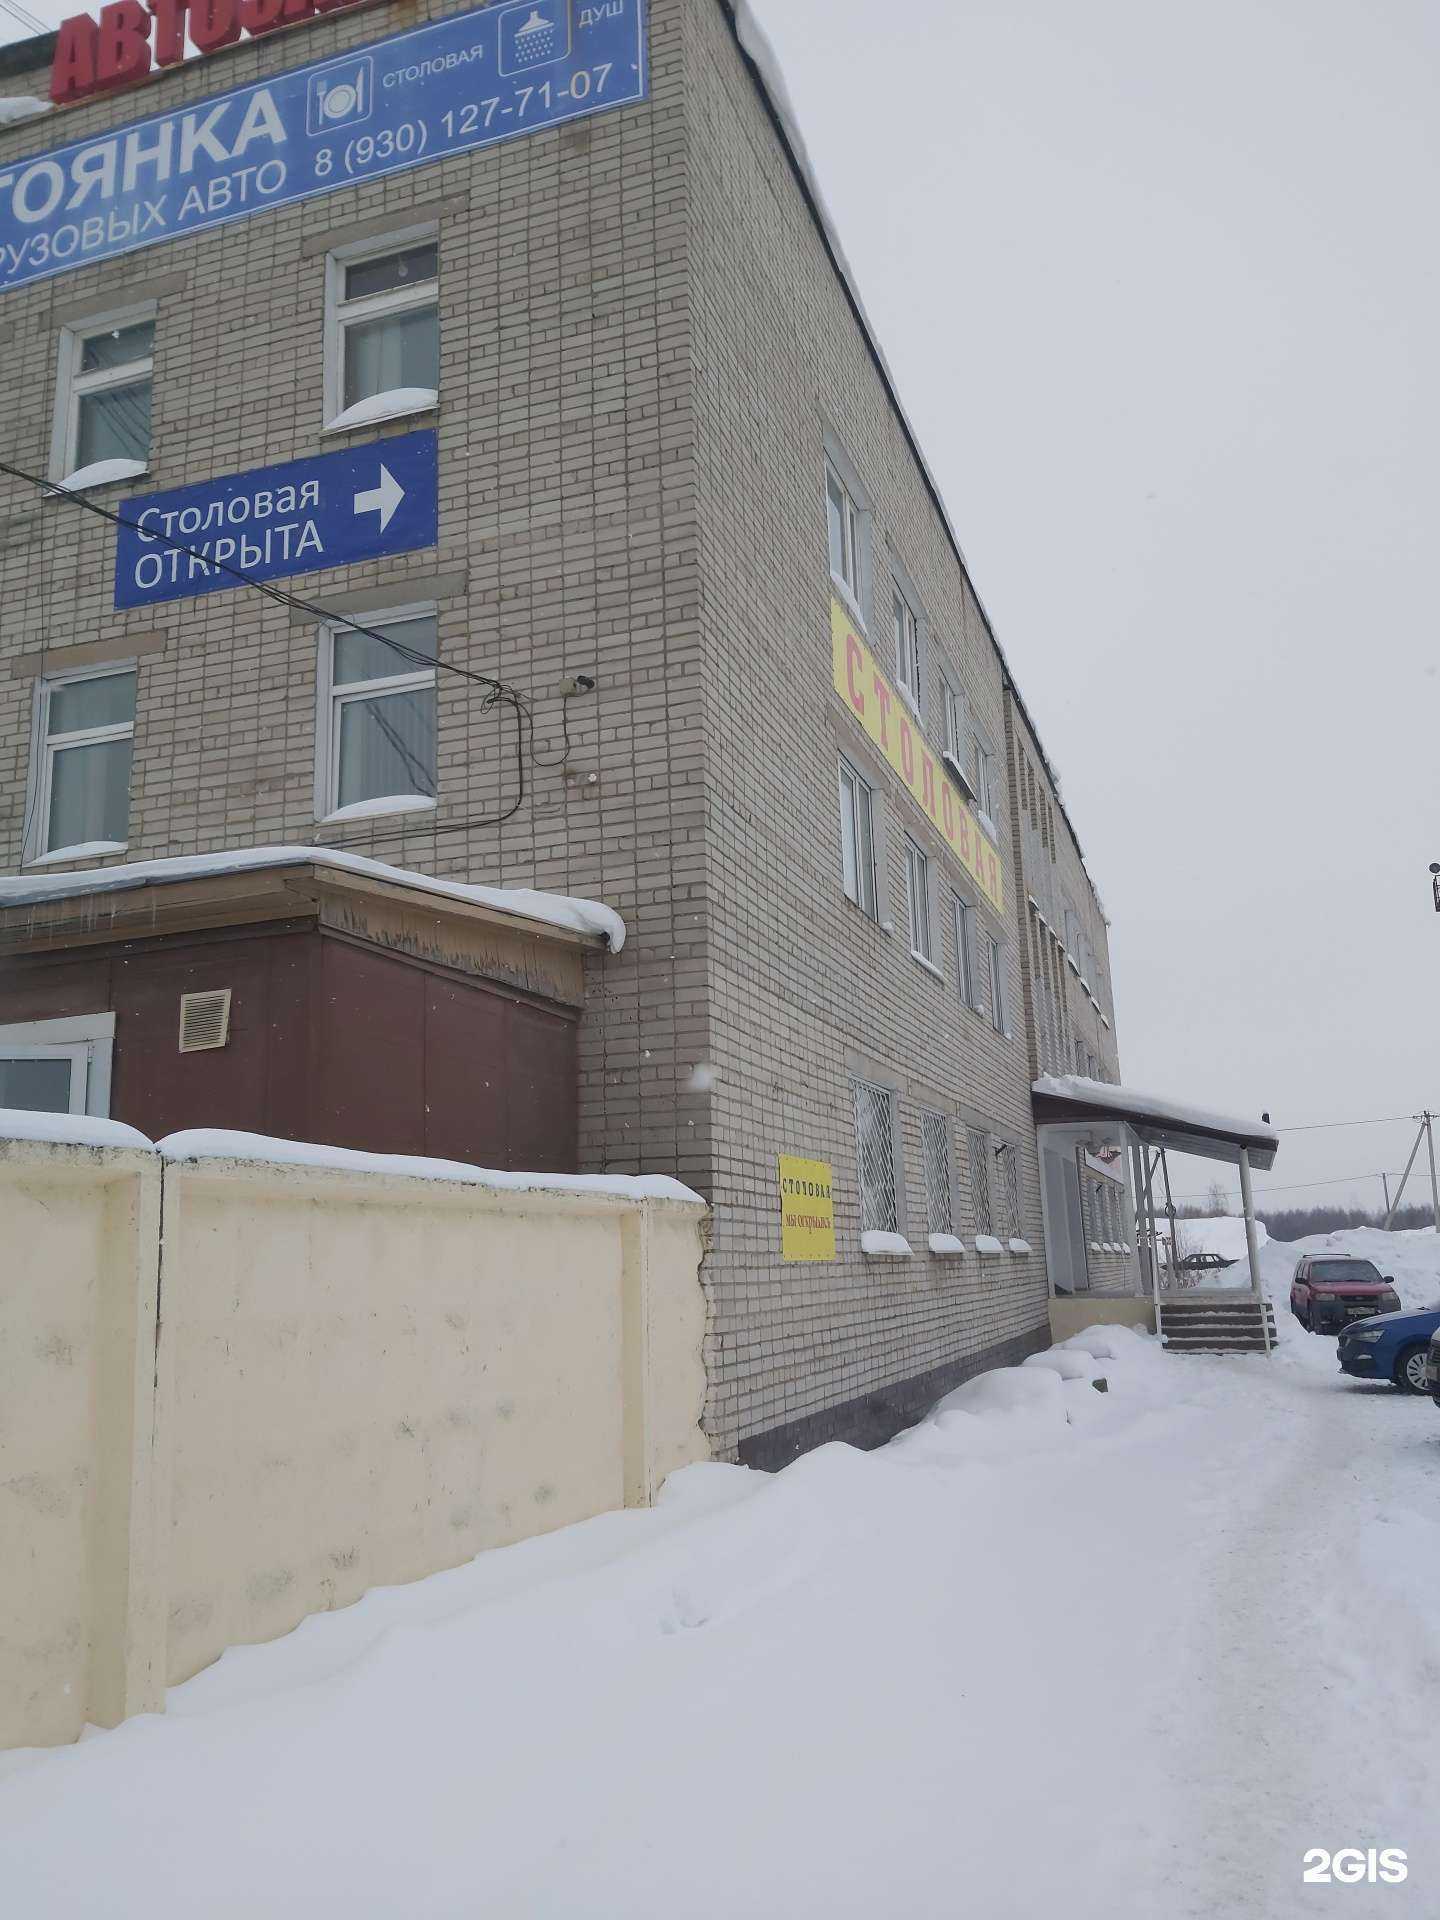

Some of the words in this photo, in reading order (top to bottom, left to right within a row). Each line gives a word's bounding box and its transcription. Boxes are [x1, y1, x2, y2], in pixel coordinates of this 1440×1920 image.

[578, 0, 624, 29] ДУШ
[382, 45, 483, 89] СТОЛОВАЯ
[314, 149, 333, 177] 8
[344, 120, 428, 174] (930)
[441, 63, 613, 138] 127-71-07
[178, 159, 287, 221] АВТО
[137, 480, 320, 542] Столовая
[134, 519, 325, 589] ОТКРЫТА
[846, 633, 998, 896] СТОЛОВАЯ
[782, 1178, 831, 1199] СТОЛОВАЯ
